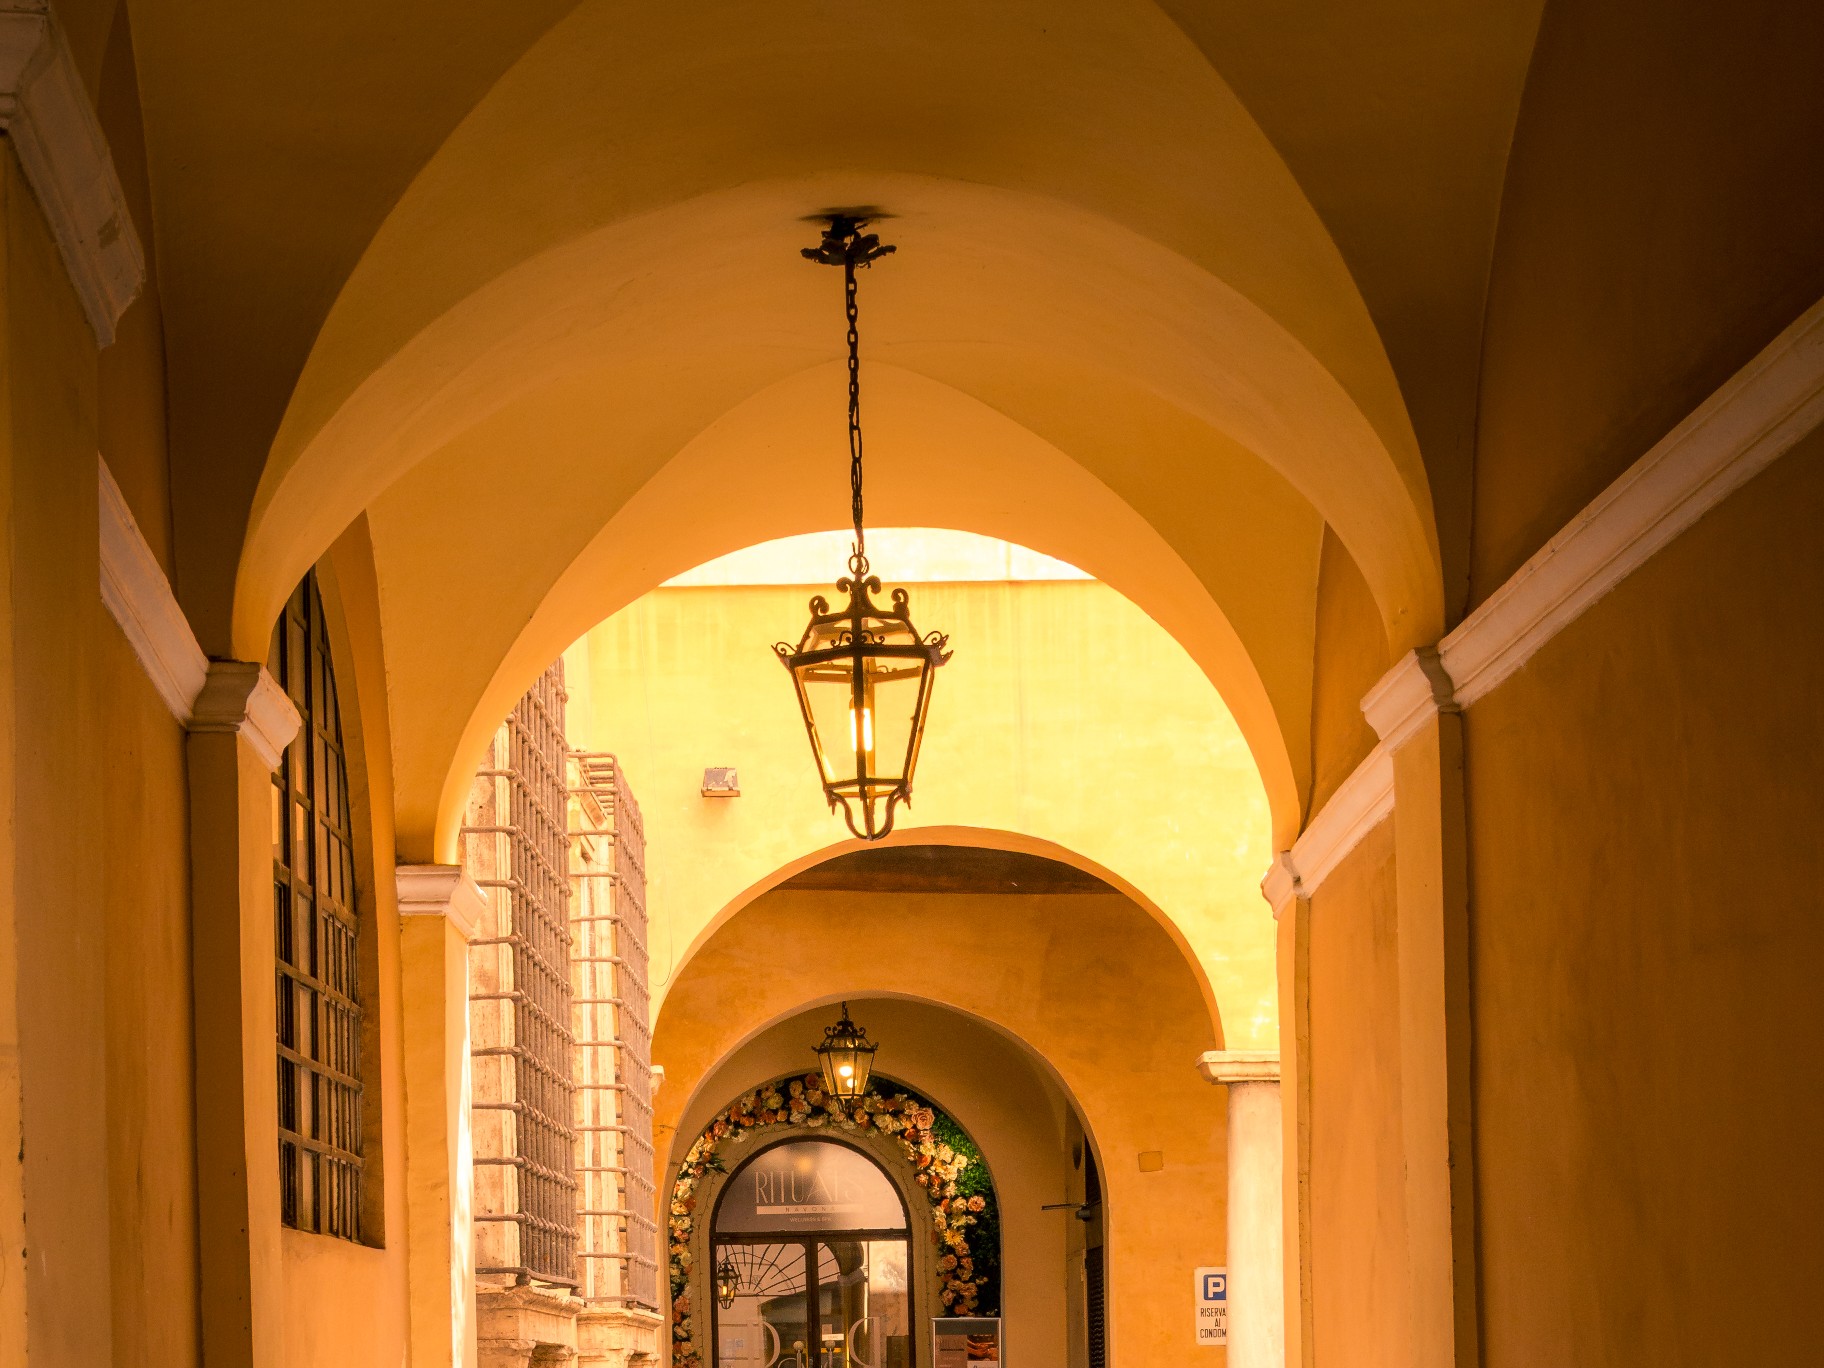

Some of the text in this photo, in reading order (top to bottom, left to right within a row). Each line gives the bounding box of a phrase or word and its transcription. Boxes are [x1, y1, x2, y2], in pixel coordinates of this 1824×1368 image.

[755, 1170, 864, 1204] RITUALS
[1207, 1277, 1225, 1298] P
[1214, 1318, 1221, 1327] AI
